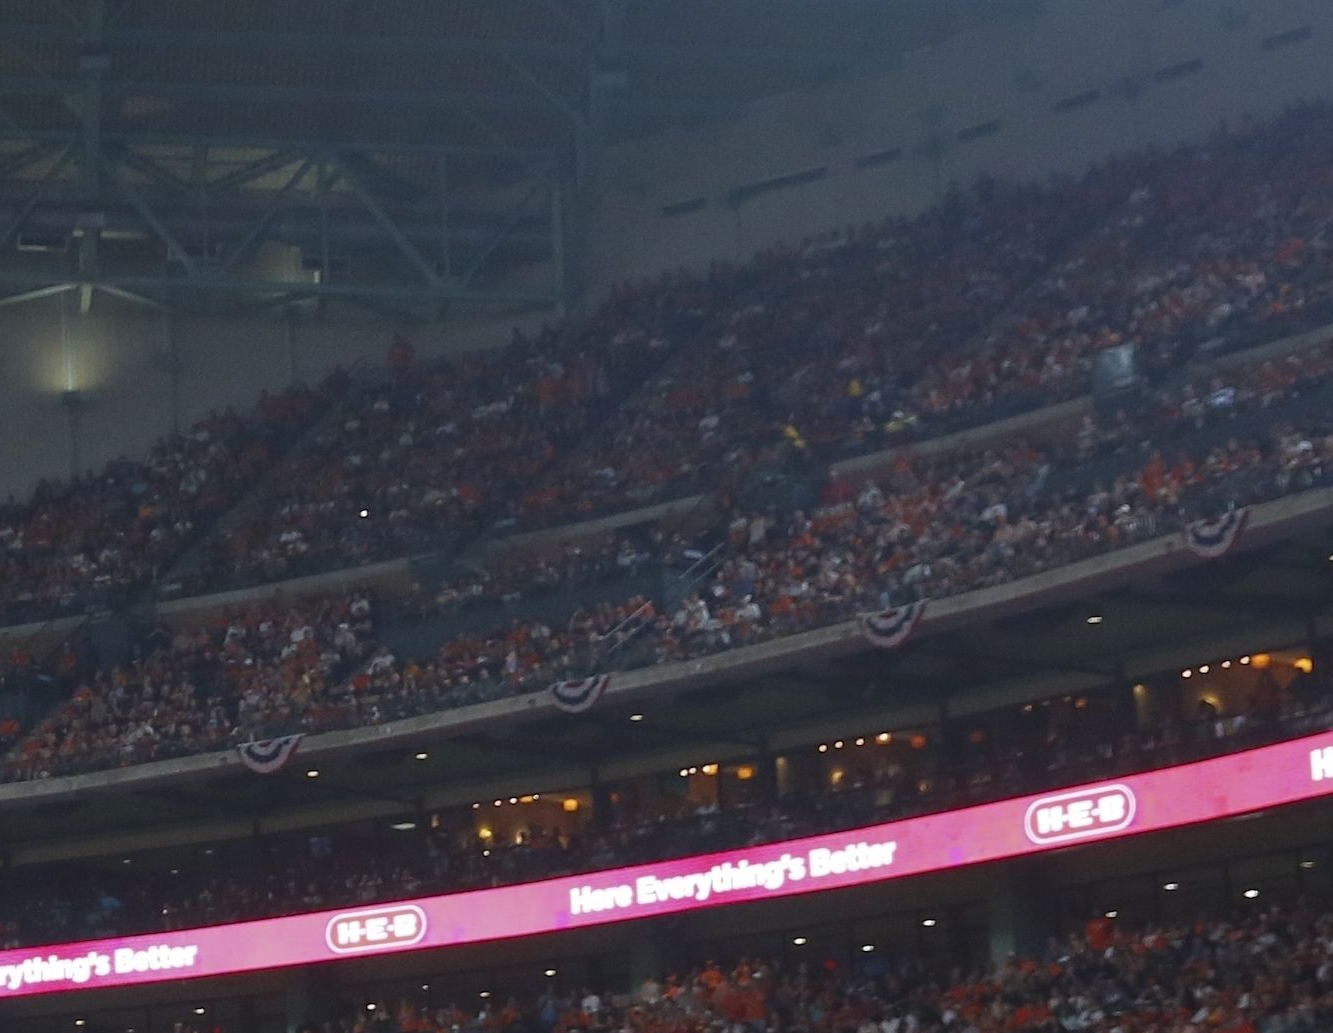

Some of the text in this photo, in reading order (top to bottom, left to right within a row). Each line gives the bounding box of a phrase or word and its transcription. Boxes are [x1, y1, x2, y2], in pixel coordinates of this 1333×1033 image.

[569, 841, 896, 914] Here Everything's Better
[115, 945, 197, 974] Better
